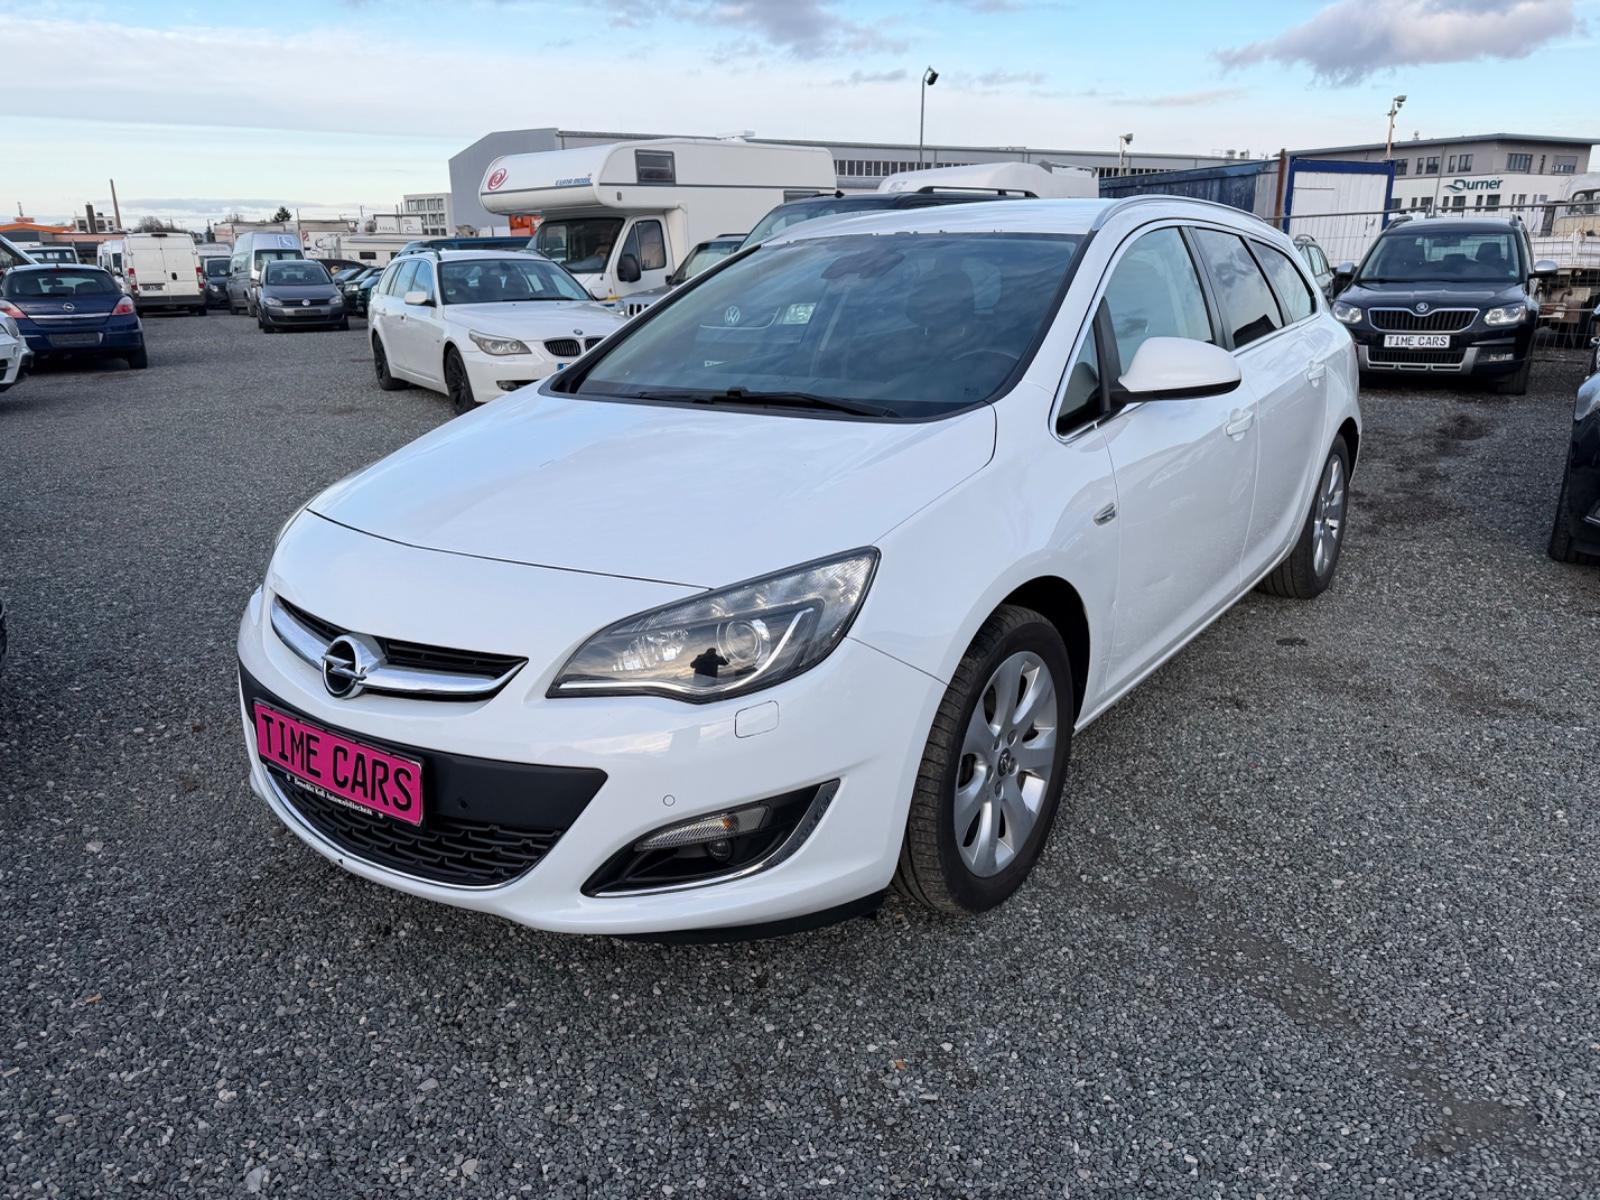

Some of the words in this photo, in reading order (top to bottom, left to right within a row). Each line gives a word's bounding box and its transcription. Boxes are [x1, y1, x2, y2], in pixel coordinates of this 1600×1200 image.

[1388, 335, 1415, 346] TIME
[1417, 336, 1448, 347] CARS
[260, 713, 322, 779] TIME
[332, 745, 413, 812] CARS
